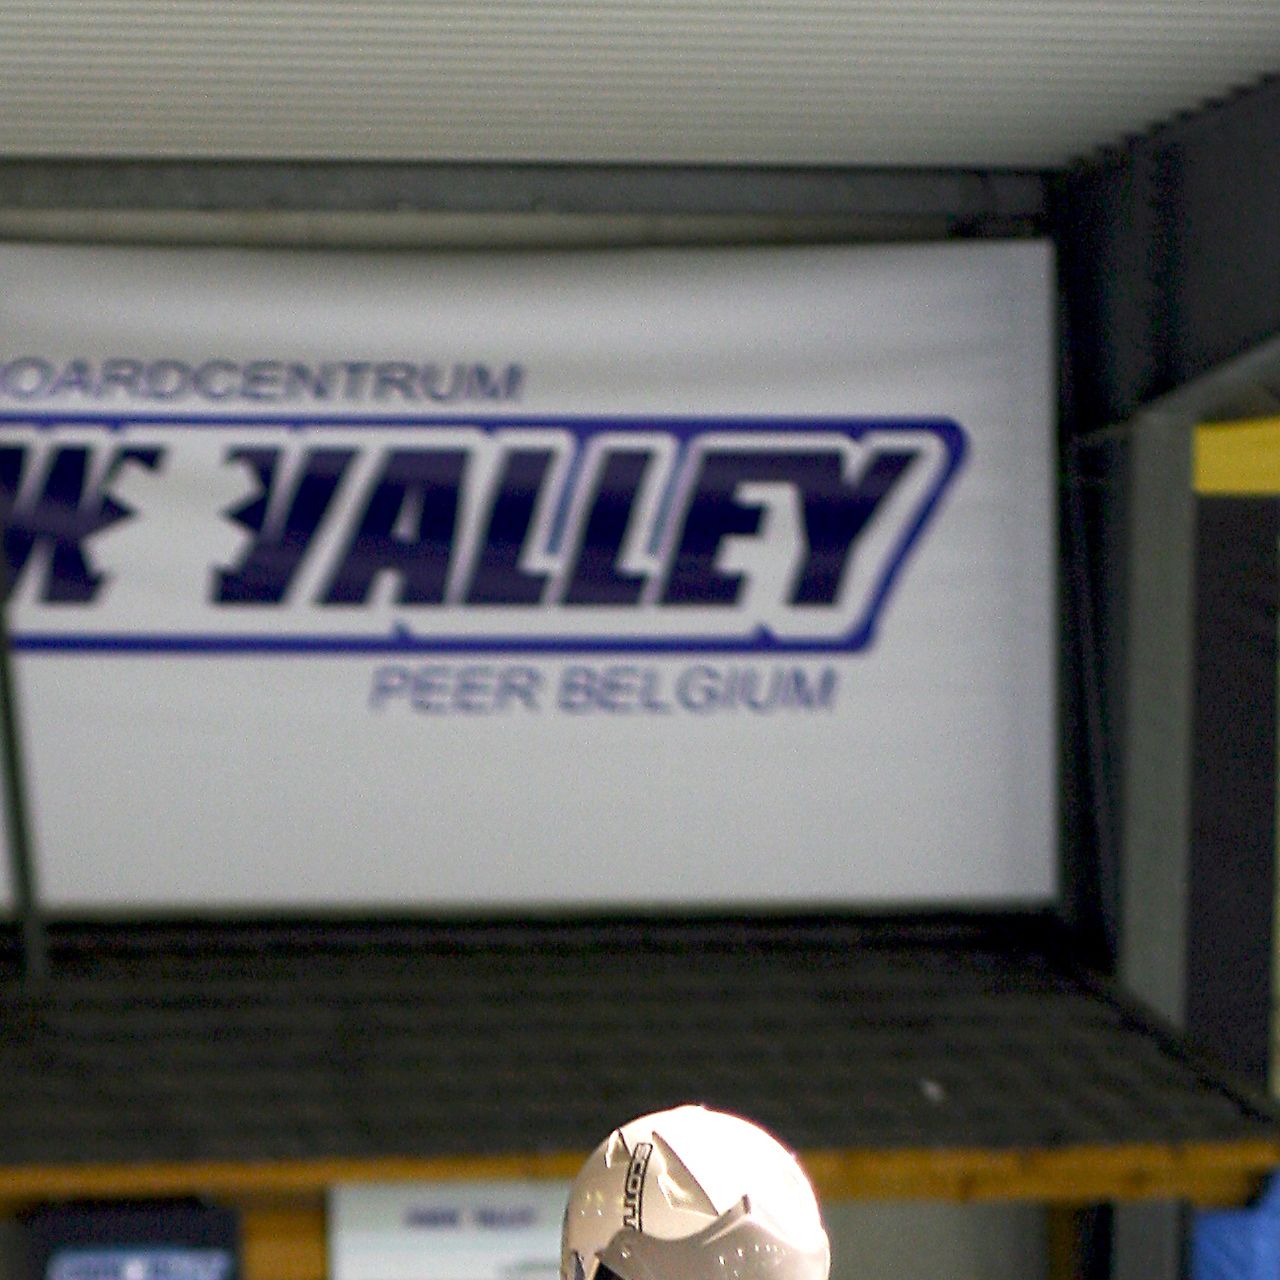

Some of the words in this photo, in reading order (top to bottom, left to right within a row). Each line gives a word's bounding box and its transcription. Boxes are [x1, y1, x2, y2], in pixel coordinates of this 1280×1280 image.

[207, 446, 927, 607] VALLEY
[368, 662, 545, 713] PEER
[557, 664, 838, 713] BELGIUM
